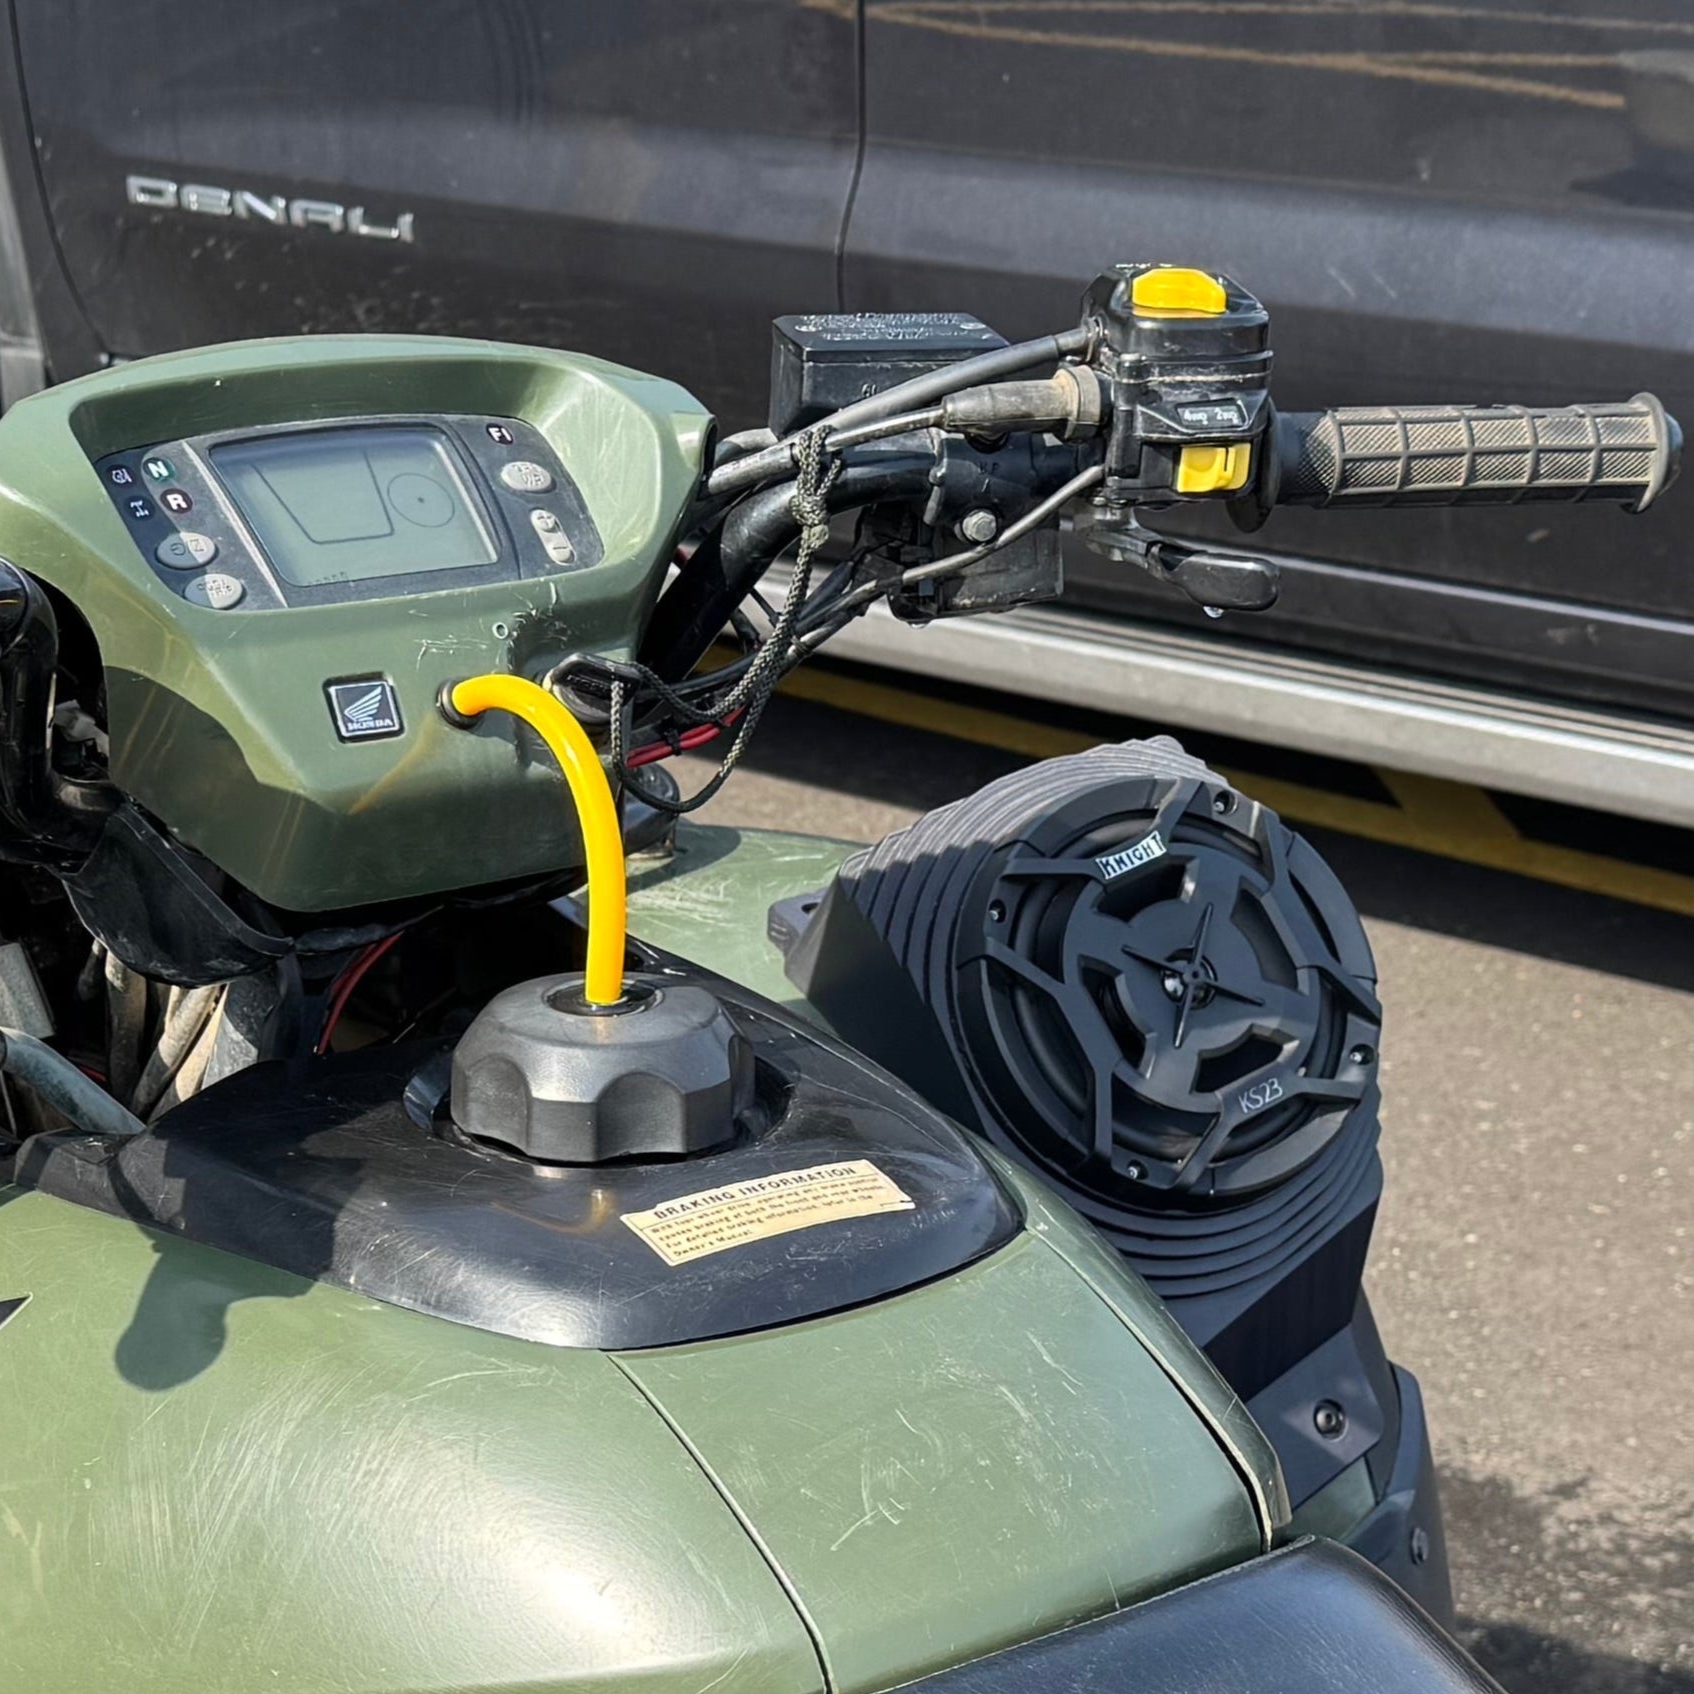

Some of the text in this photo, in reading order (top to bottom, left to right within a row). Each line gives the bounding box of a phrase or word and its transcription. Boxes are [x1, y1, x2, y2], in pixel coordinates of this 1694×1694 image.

[125, 174, 415, 242] DENALI
[488, 427, 512, 442] FI
[147, 461, 169, 478] N
[166, 493, 188, 511] R
[1100, 832, 1166, 877] KNIGHT
[1237, 1077, 1284, 1113] KS23
[653, 1191, 736, 1219] BRAKING
[738, 1167, 857, 1196] INFORMATION
